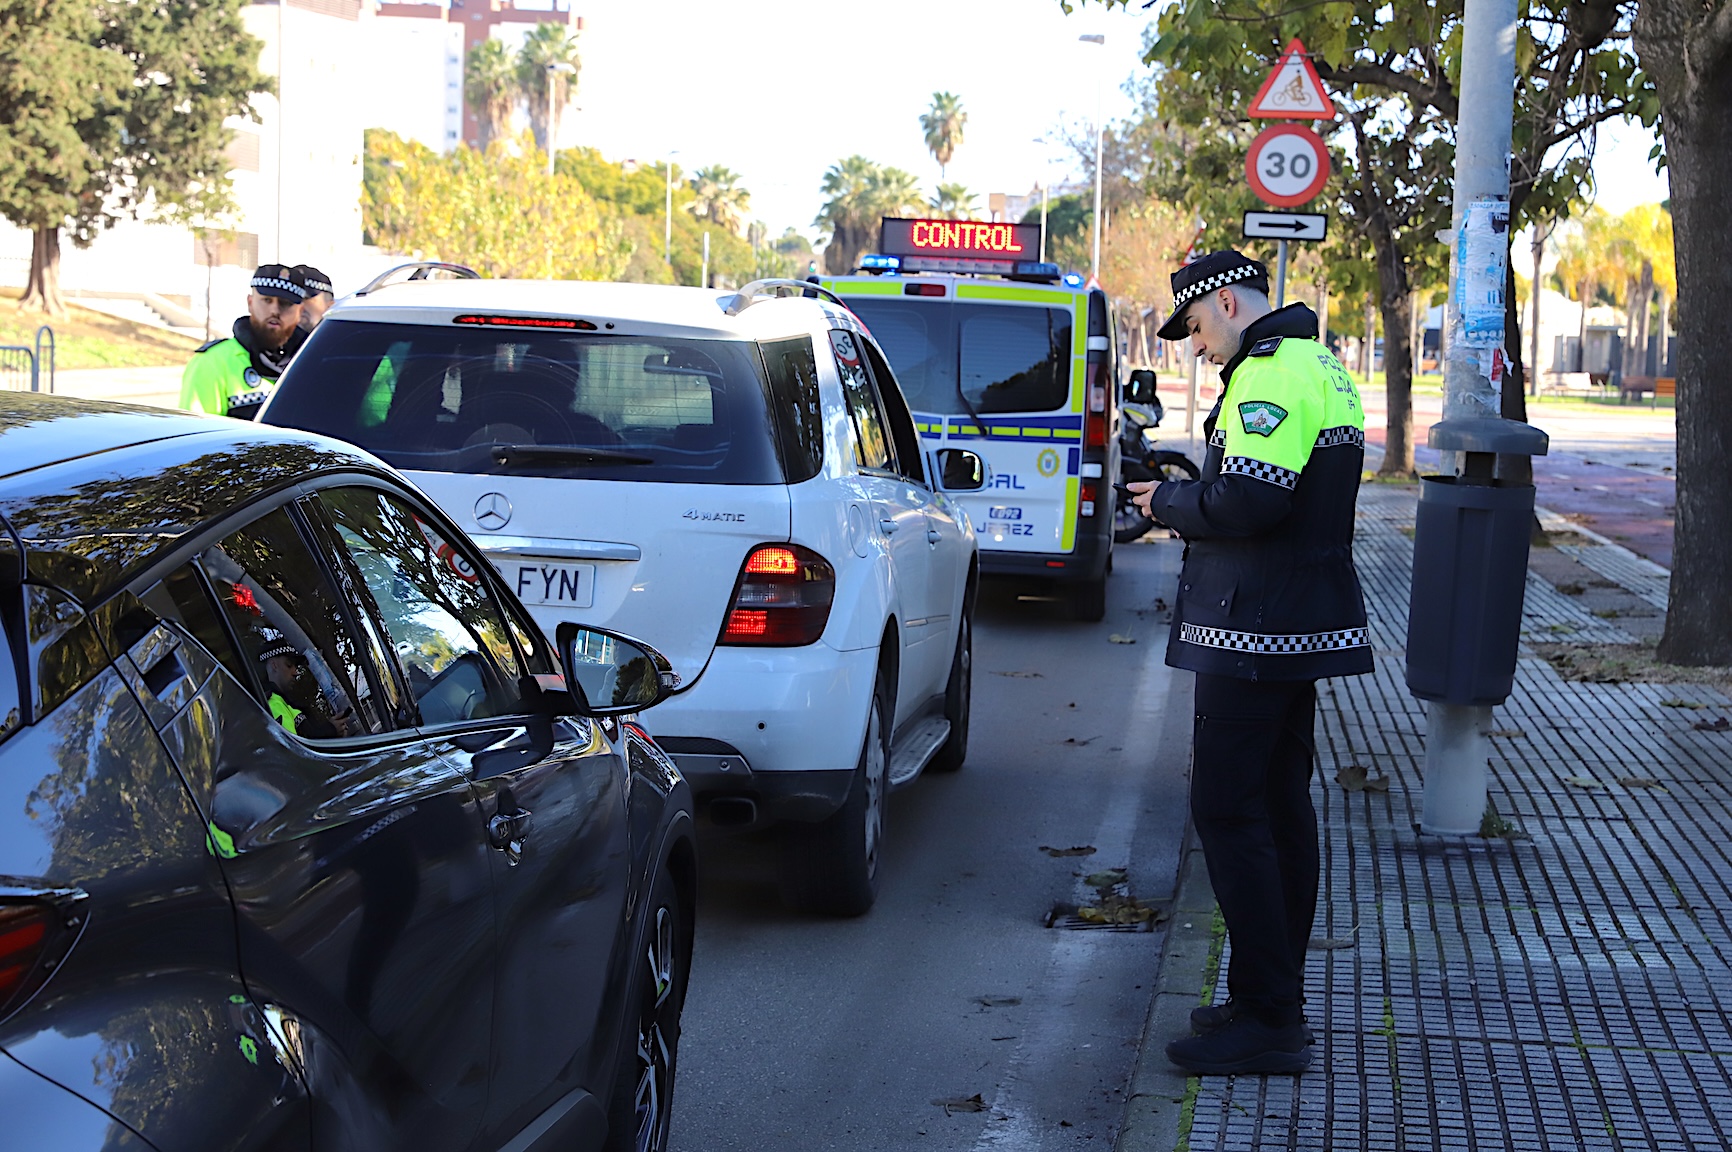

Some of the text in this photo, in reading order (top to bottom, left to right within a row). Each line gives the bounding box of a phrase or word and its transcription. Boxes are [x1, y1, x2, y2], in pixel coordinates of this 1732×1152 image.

[1265, 152, 1311, 179] 30
[912, 221, 1022, 252] CONTROL
[1267, 405, 1283, 415] LOCAL
[998, 508, 1020, 520] 092
[976, 521, 1034, 537] JEREZ
[517, 565, 580, 602] FYN
